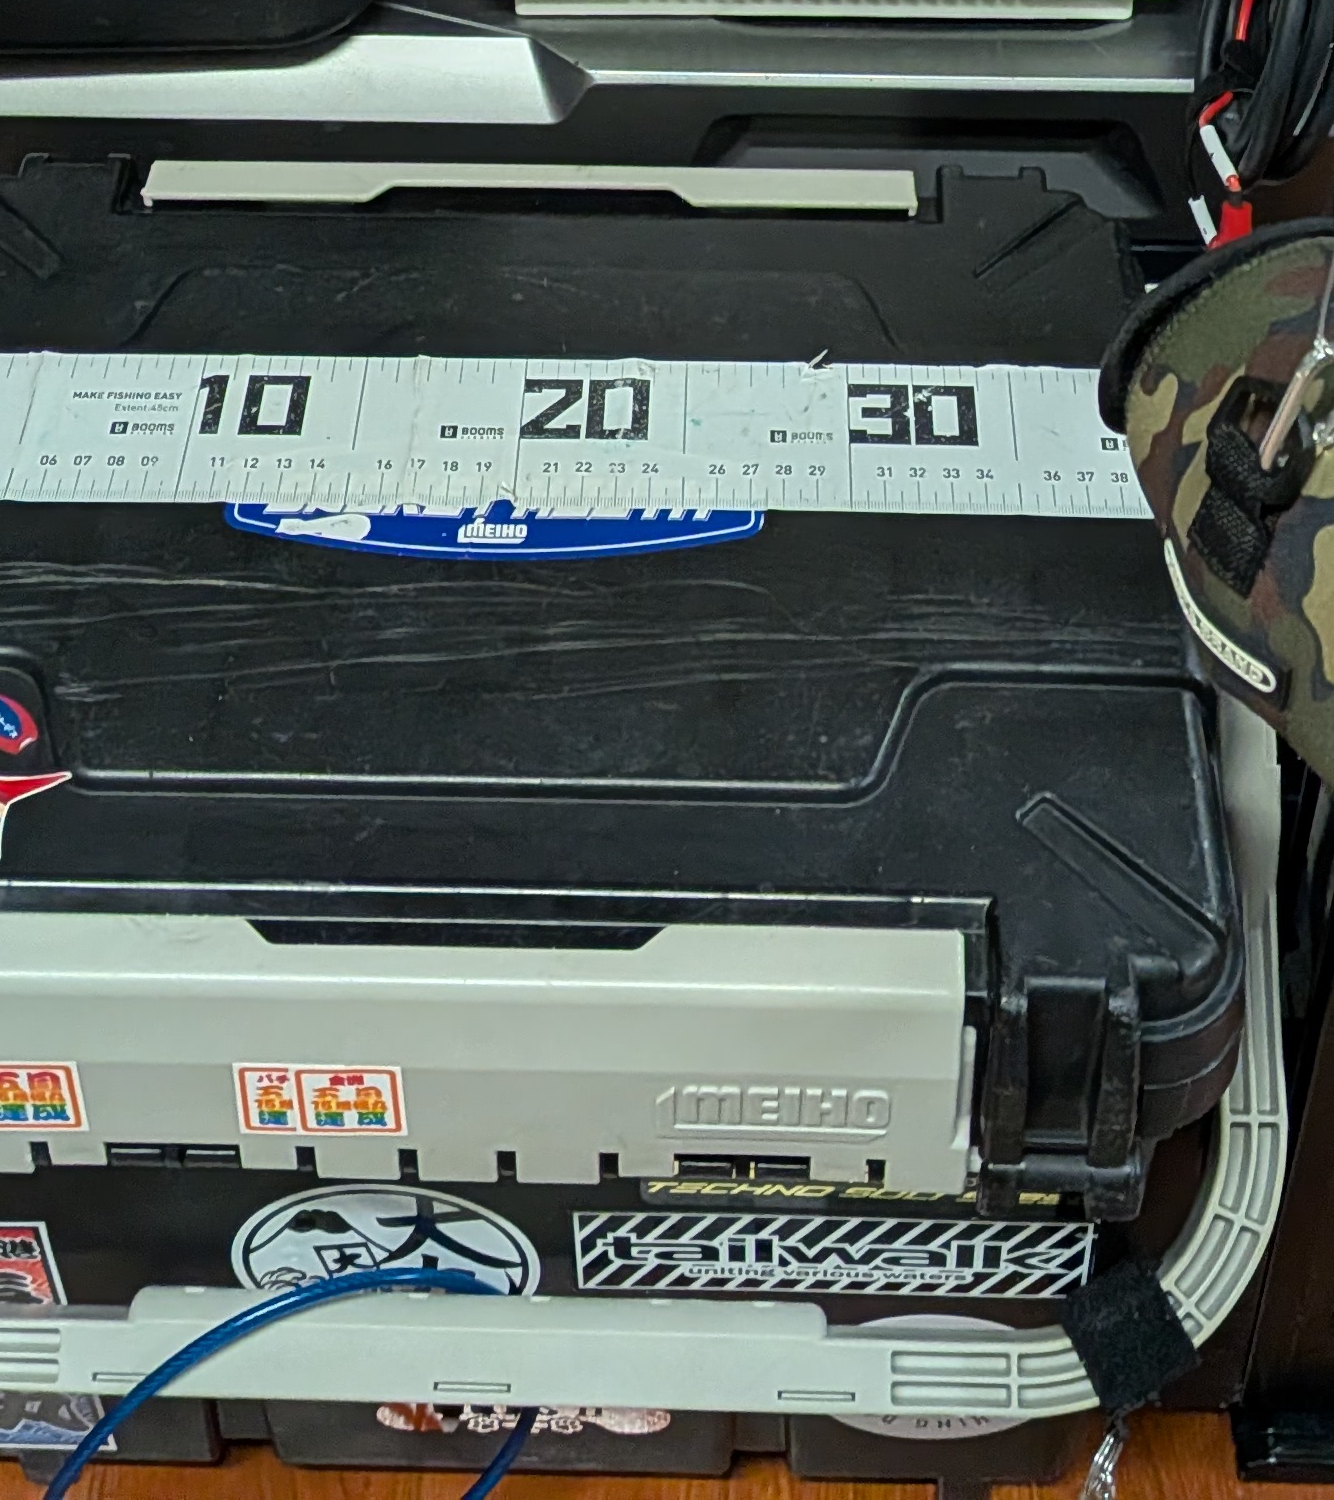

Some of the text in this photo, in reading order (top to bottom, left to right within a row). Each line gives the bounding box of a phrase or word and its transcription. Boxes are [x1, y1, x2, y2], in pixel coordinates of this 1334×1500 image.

[72, 390, 183, 400] MAKE FISHING EASY
[199, 373, 313, 437] 10
[520, 376, 651, 441] 20
[847, 382, 980, 448] 30
[130, 422, 175, 433] BOOMS
[461, 426, 505, 436] BOOMS
[39, 454, 58, 466] 06
[73, 455, 93, 466] 07
[106, 455, 126, 467] 08
[140, 455, 159, 467] 09
[210, 456, 225, 468] 11
[276, 457, 293, 469] 13
[309, 458, 326, 470] 14
[376, 459, 393, 470] 16
[442, 460, 459, 472] 18
[475, 461, 493, 473] 19
[542, 461, 559, 474] 21
[574, 461, 593, 473] 22
[641, 462, 660, 474] 24
[708, 463, 726, 475] 26
[742, 463, 760, 476] 27
[775, 464, 793, 476] 28
[808, 464, 826, 477] 29
[876, 466, 893, 478] 31
[909, 466, 927, 479] 32
[942, 467, 961, 479] 33
[975, 468, 994, 480] 34
[1043, 470, 1062, 482] 36
[1076, 471, 1095, 482] 37
[1110, 472, 1129, 484] 38
[465, 522, 528, 538] MEIHO
[674, 1085, 892, 1129] MEIHO
[646, 1181, 835, 1198] TECHNO
[598, 1231, 1077, 1274] tailwalk
[687, 1266, 969, 1283] uniting various waters
